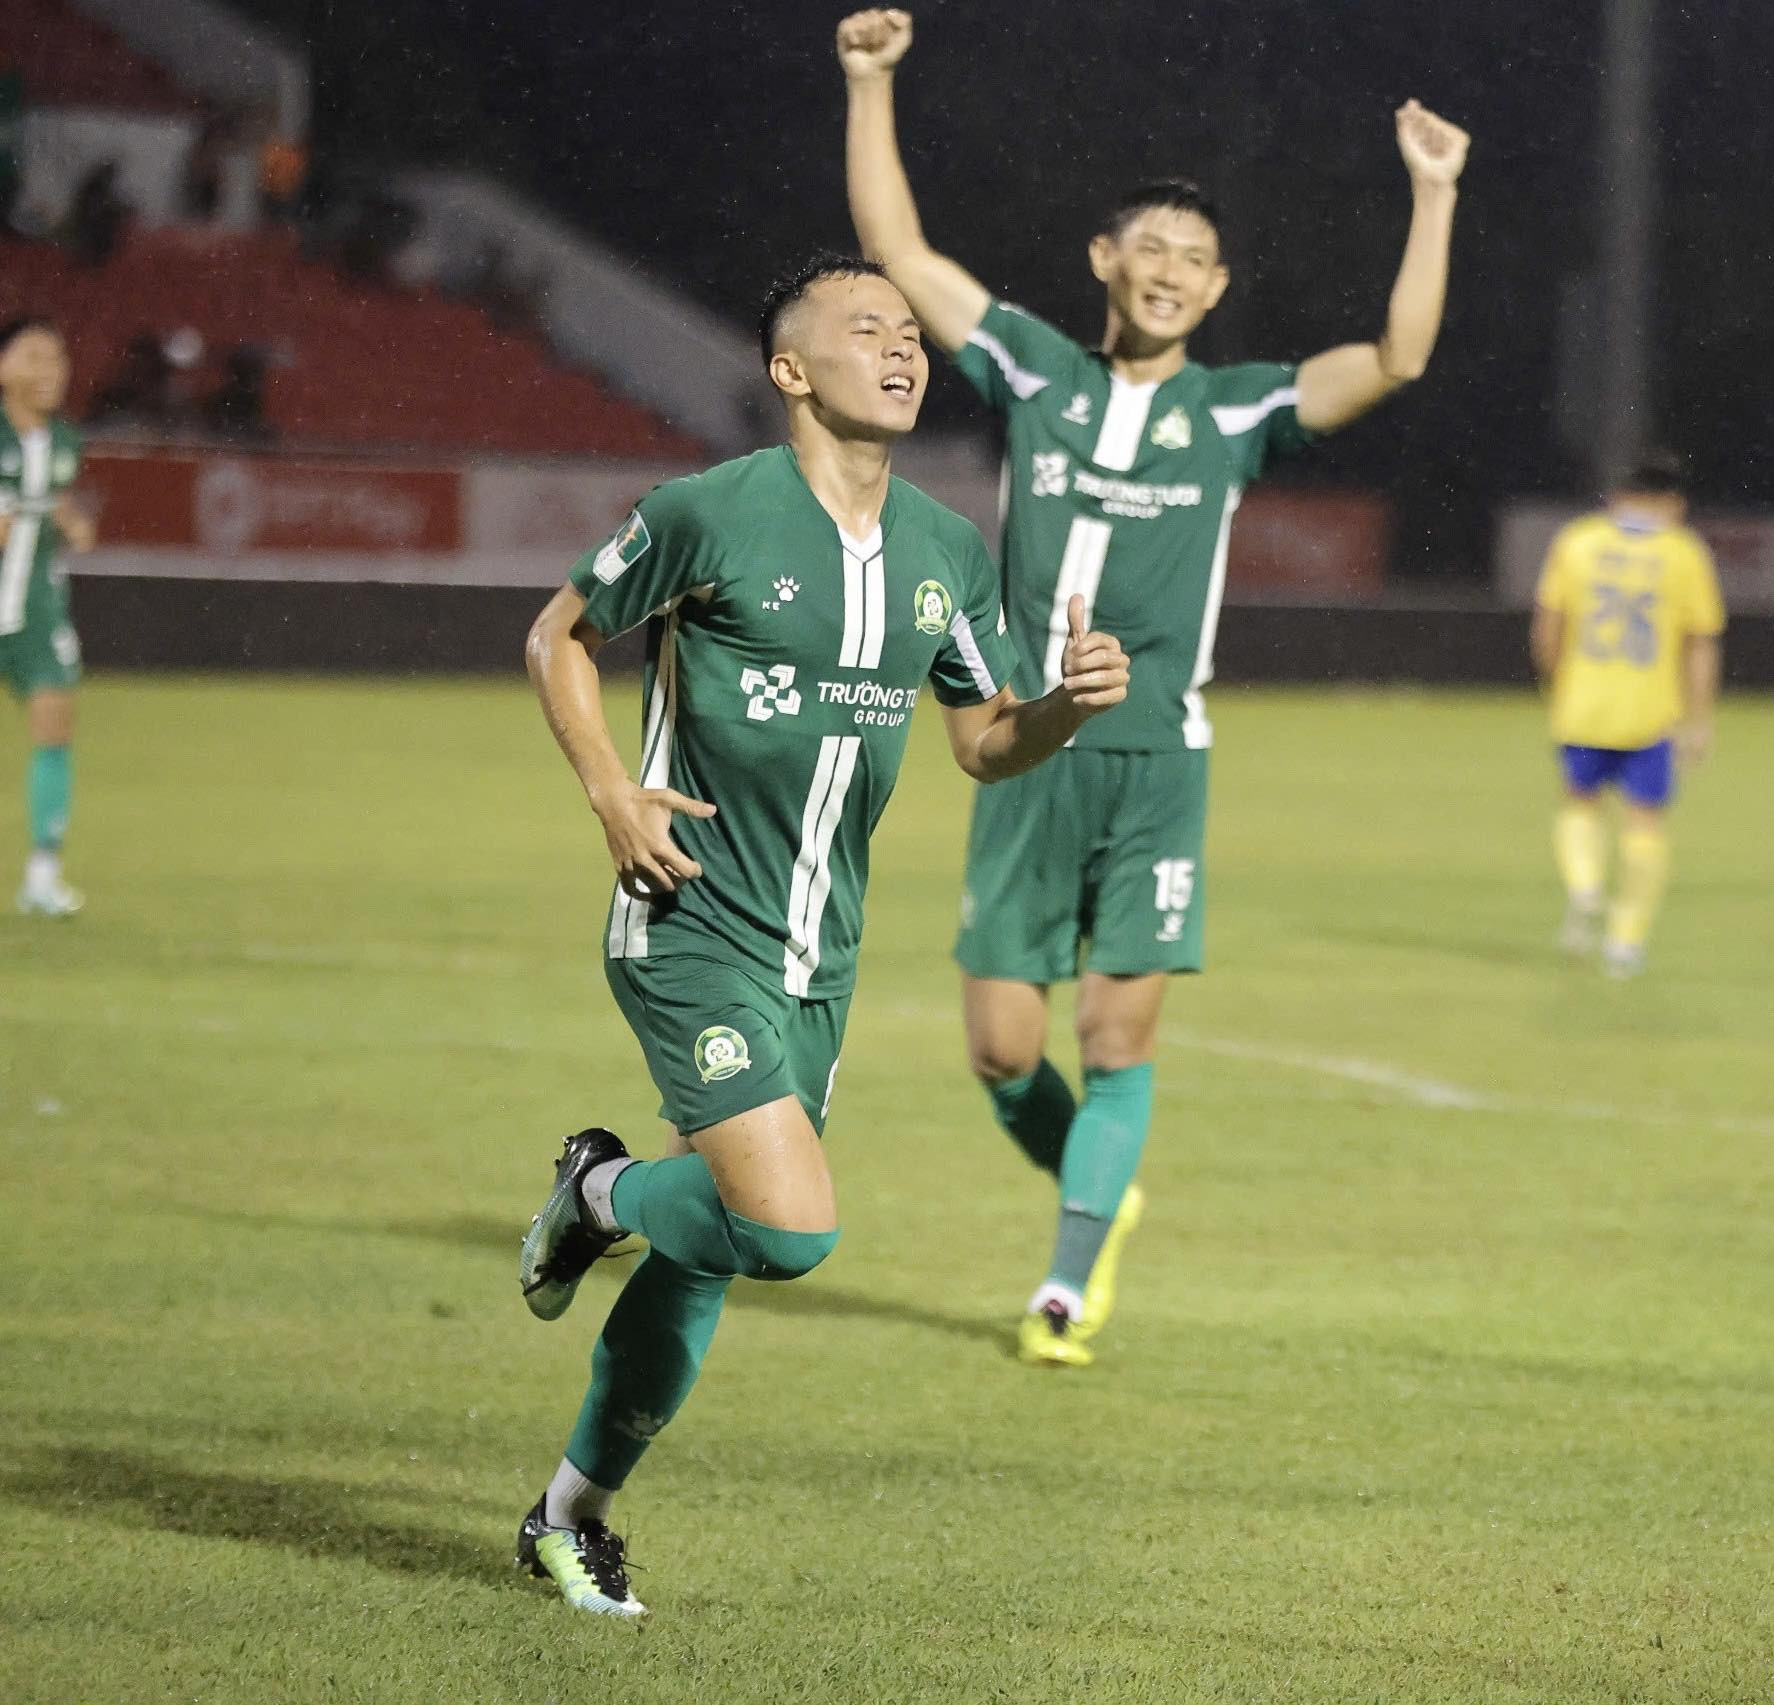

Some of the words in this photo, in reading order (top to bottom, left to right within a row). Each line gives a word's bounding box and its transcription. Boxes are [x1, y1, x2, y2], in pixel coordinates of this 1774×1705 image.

[817, 680, 904, 709] TRƯỜNG
[853, 709, 905, 727] GROUP
[1152, 859, 1195, 911] 15
